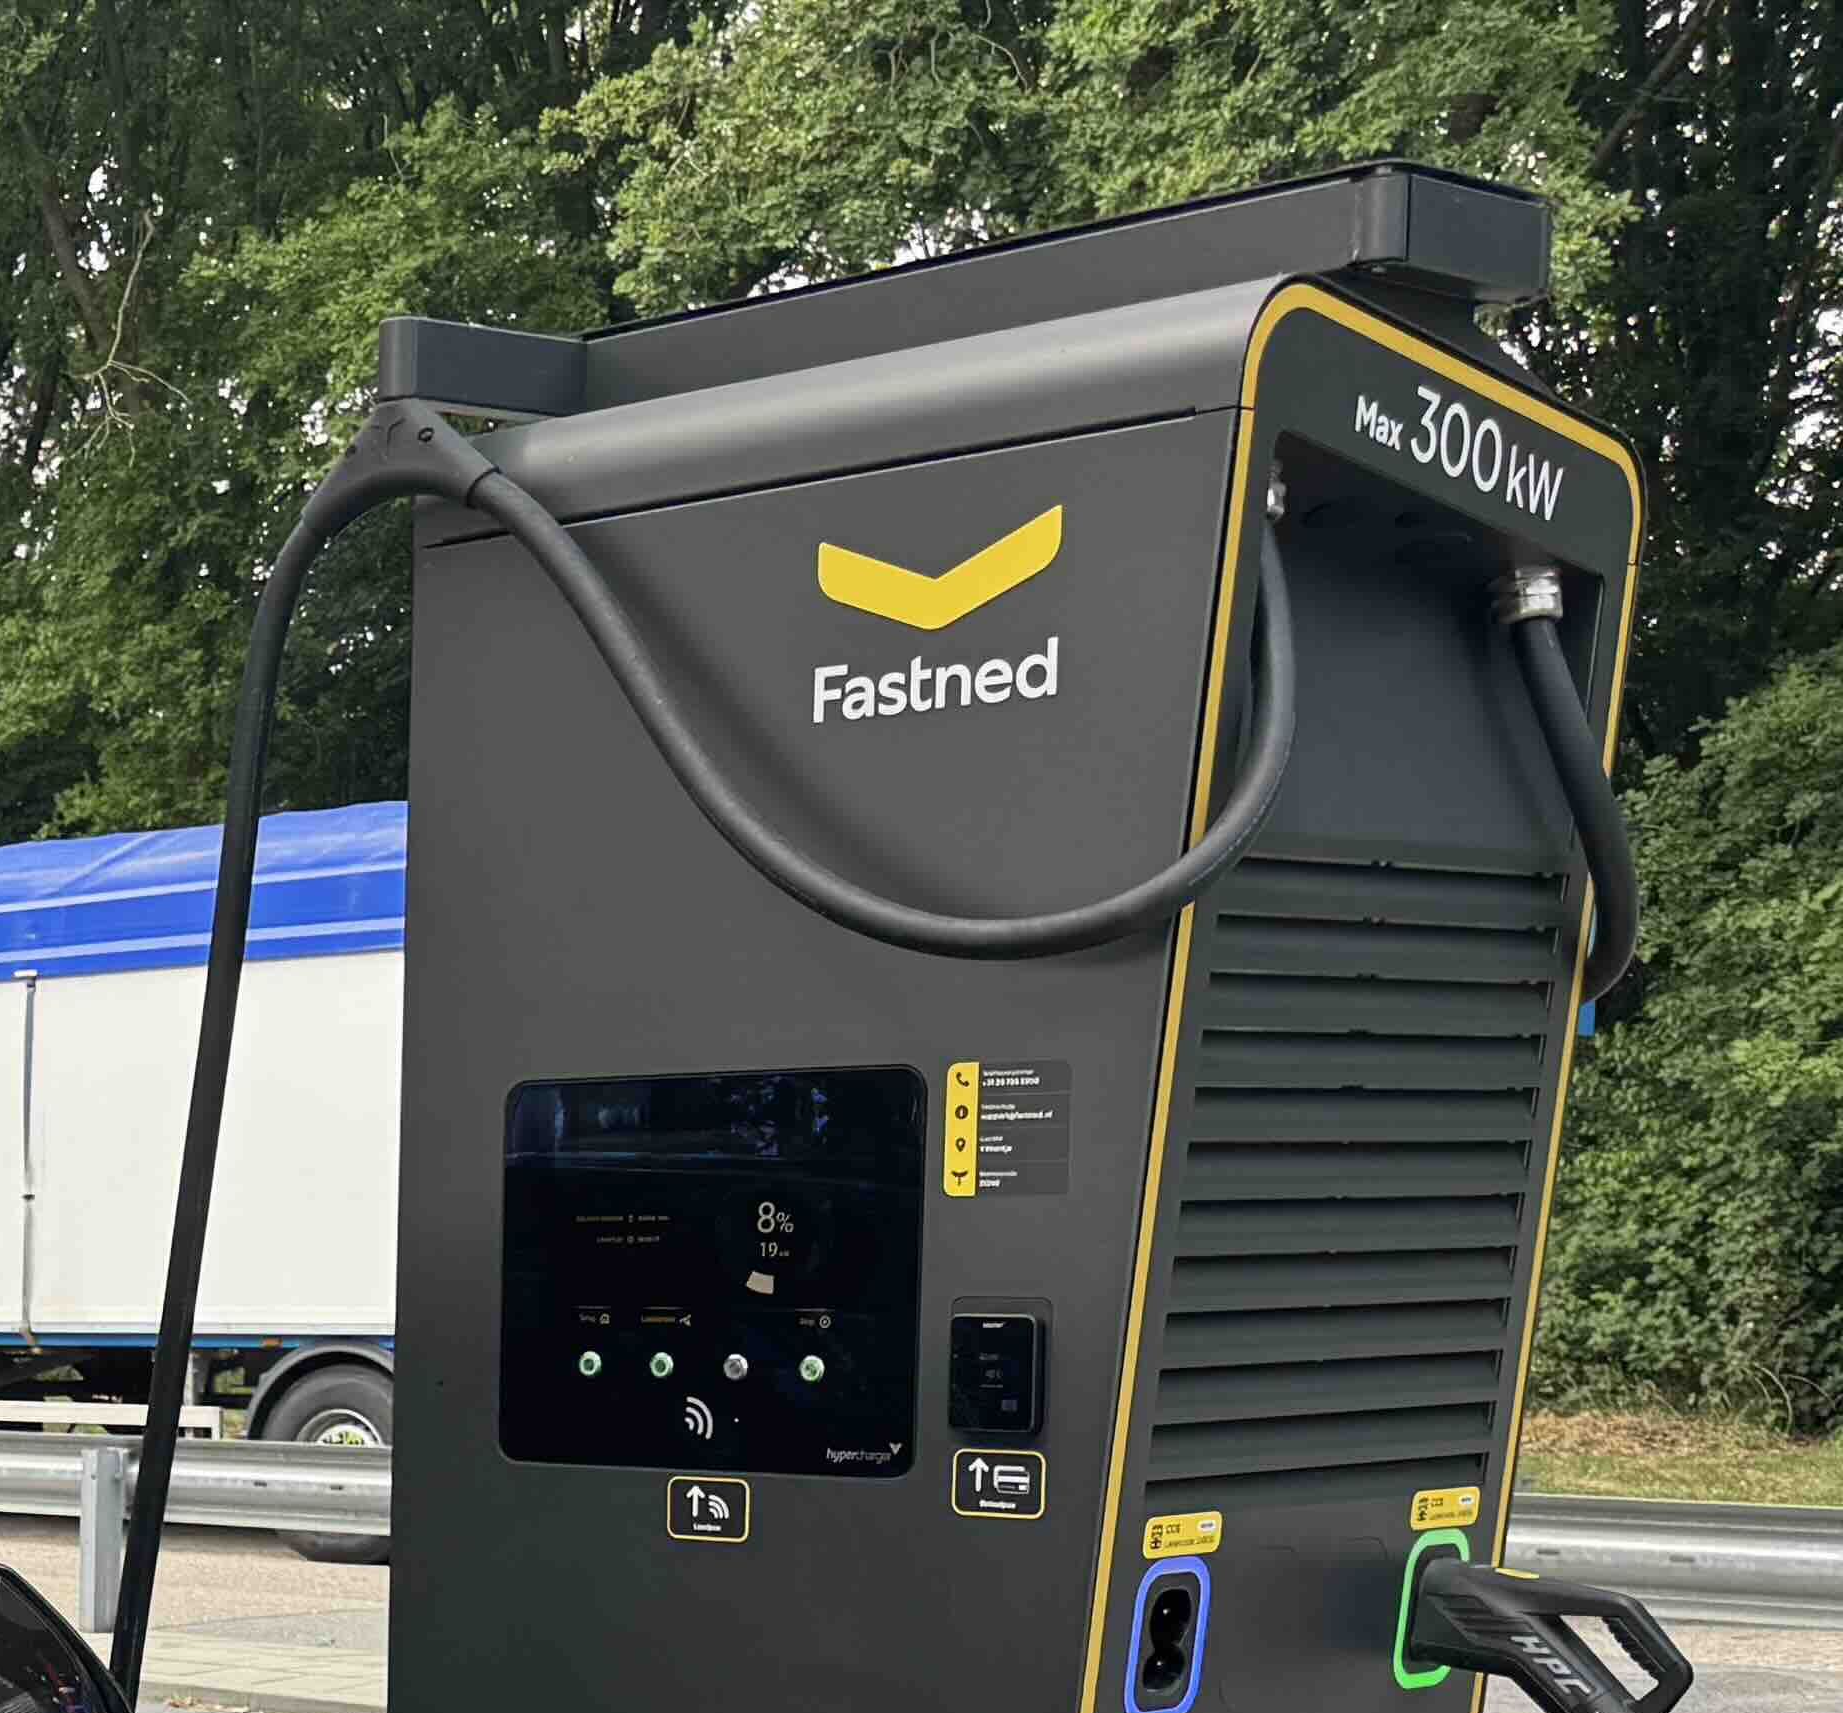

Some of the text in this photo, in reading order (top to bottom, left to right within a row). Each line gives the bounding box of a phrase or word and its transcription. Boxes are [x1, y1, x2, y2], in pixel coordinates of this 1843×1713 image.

[1354, 394, 1403, 451] Max
[1410, 385, 1502, 493] 300
[811, 636, 1059, 724] Fastned
[756, 1201, 795, 1234] 8%
[759, 1241, 779, 1258] 19
[1510, 1635, 1591, 1695] HPC
